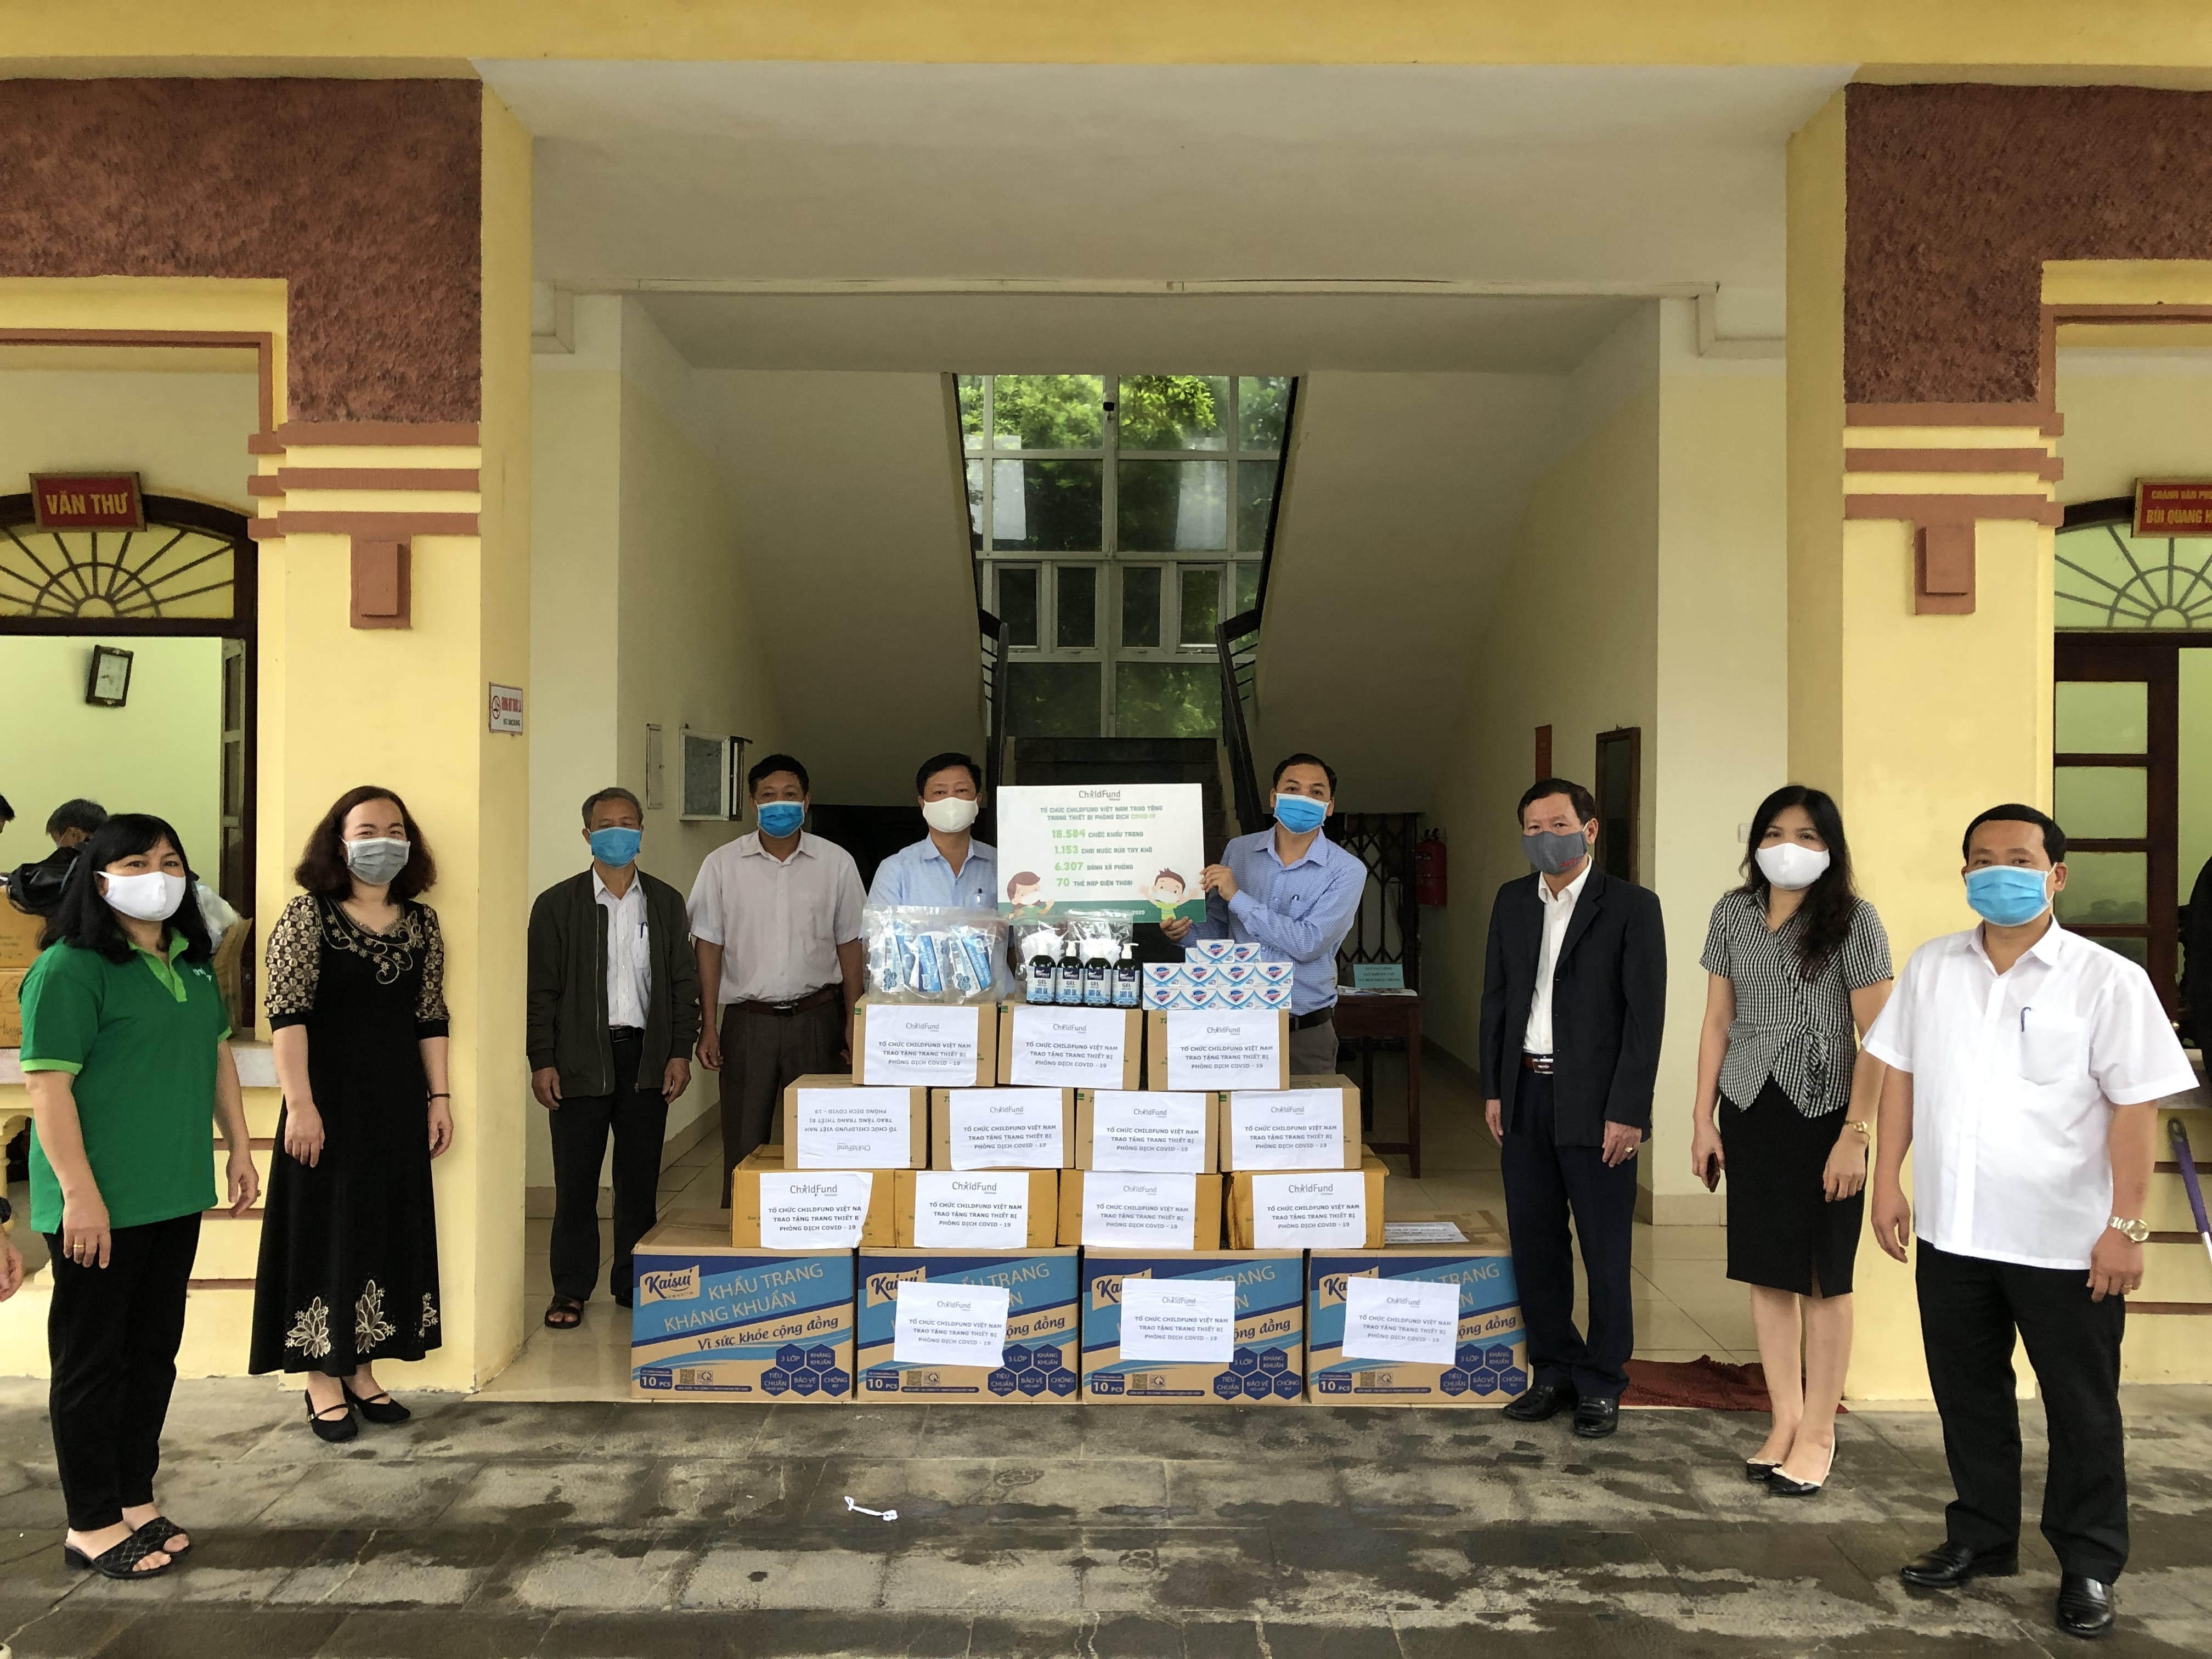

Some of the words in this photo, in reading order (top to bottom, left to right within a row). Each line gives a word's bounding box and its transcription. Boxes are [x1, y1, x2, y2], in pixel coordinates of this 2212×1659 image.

[46, 489, 86, 515] VĂN
[90, 491, 128, 515] THƯ
[2168, 509, 2202, 524] QUANG
[1079, 790, 1120, 798] ChildFund
[1052, 830, 1086, 838] 18.584
[1054, 845, 1079, 854] 1.153
[1055, 862, 1084, 871] 6.307
[1057, 878, 1069, 887] 70
[790, 1184, 837, 1194] ChildFund
[1289, 1184, 1333, 1193] ChildFund
[986, 1263, 1050, 1288] TRANG
[1438, 1263, 1500, 1285] TRANG
[709, 1276, 758, 1301] KHẨU
[760, 1263, 823, 1289] TRANG
[664, 1306, 729, 1332] KHÁNG
[733, 1290, 797, 1318] KHUẨN
[1006, 1323, 1029, 1339] ộng
[1034, 1316, 1065, 1330] đồng
[1260, 1319, 1291, 1334] đồng
[1458, 1323, 1481, 1339] ộng
[1486, 1315, 1516, 1330] đồng
[697, 1338, 712, 1350] Vì
[715, 1335, 735, 1348] sức
[740, 1328, 769, 1344] khỏe
[773, 1325, 802, 1338] cộng
[807, 1316, 838, 1331] đồng
[641, 1376, 656, 1386] 10
[867, 1378, 883, 1389] 10
[1093, 1381, 1108, 1392] 10
[1321, 1380, 1336, 1391] 10
